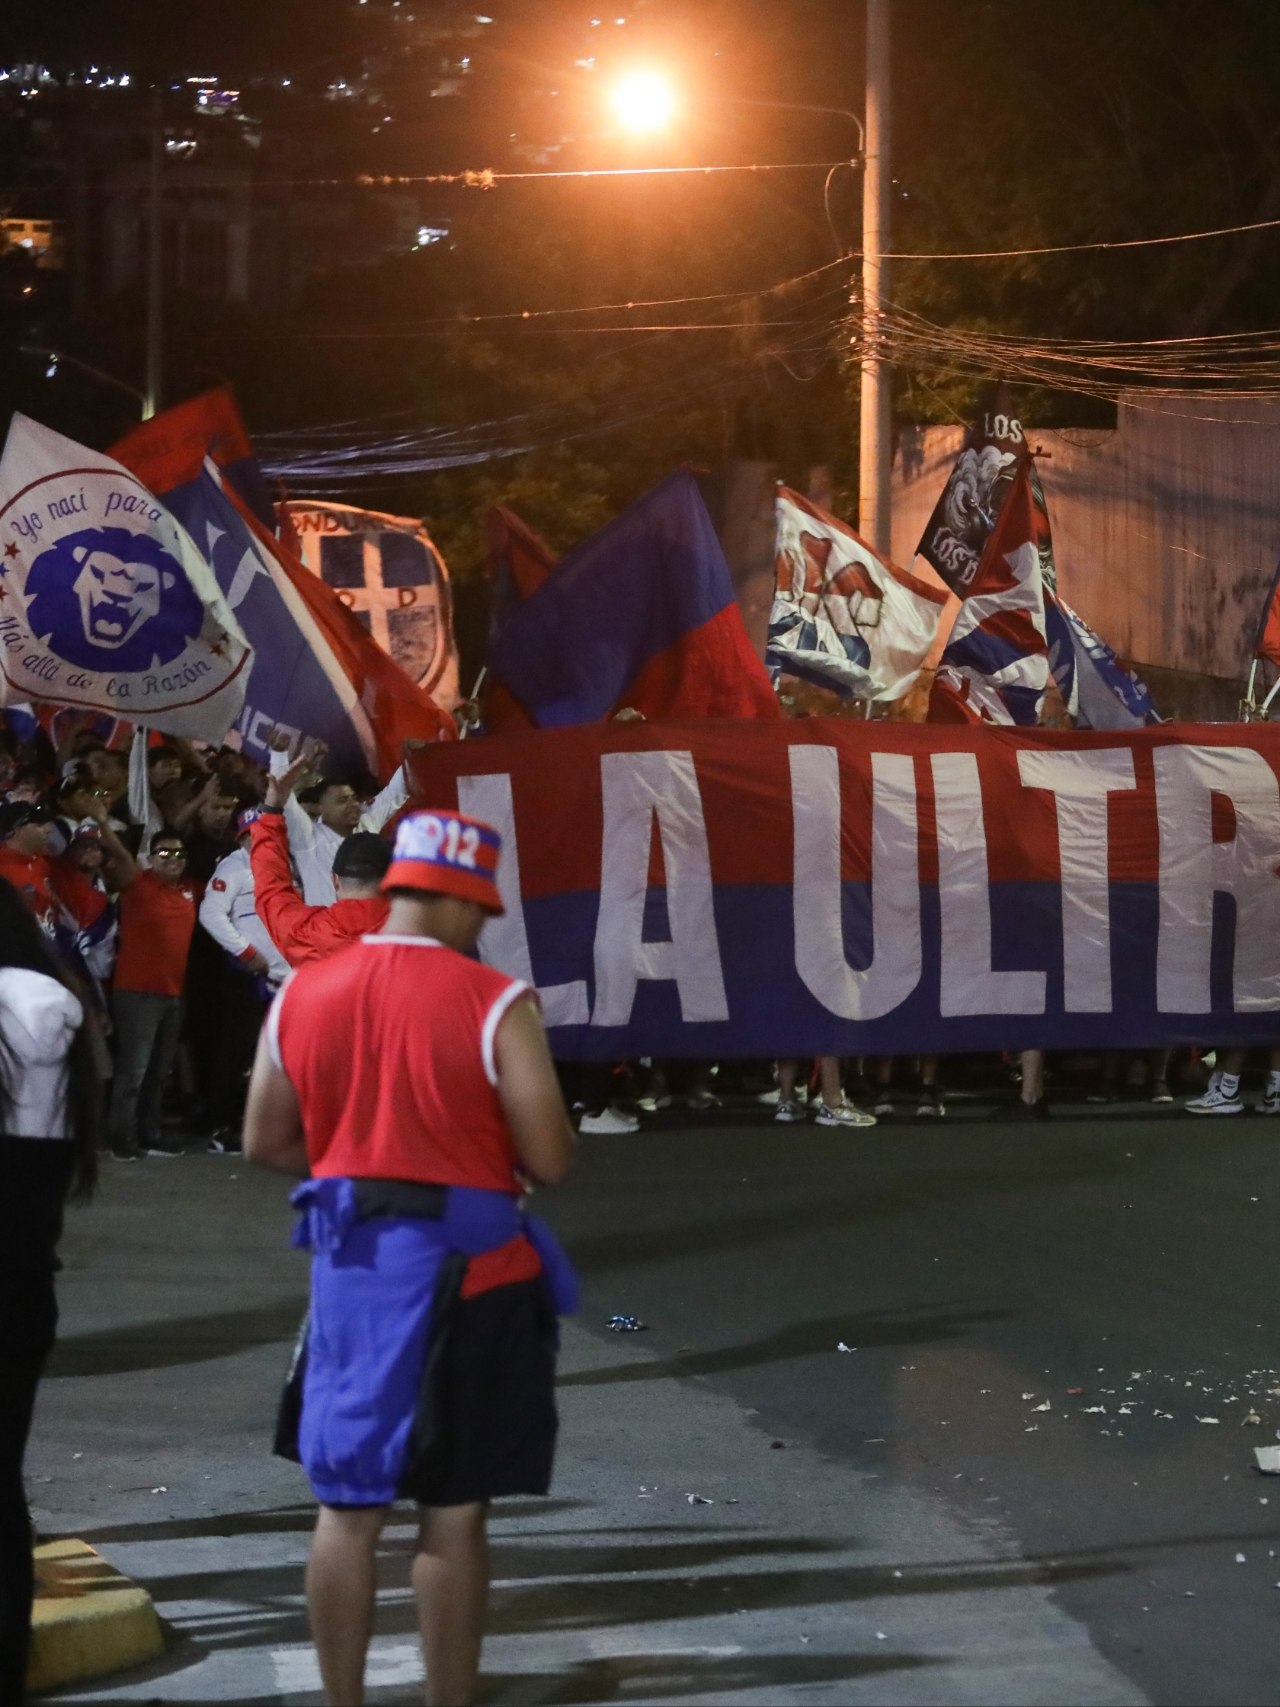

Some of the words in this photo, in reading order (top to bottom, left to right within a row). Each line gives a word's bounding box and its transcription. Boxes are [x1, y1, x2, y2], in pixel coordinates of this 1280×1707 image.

[984, 412, 1023, 444] LOS
[104, 491, 163, 522] para
[66, 672, 94, 690] de
[106, 679, 130, 698] la
[142, 657, 214, 696] Razón
[444, 818, 479, 870] 12
[457, 749, 730, 1027] LA
